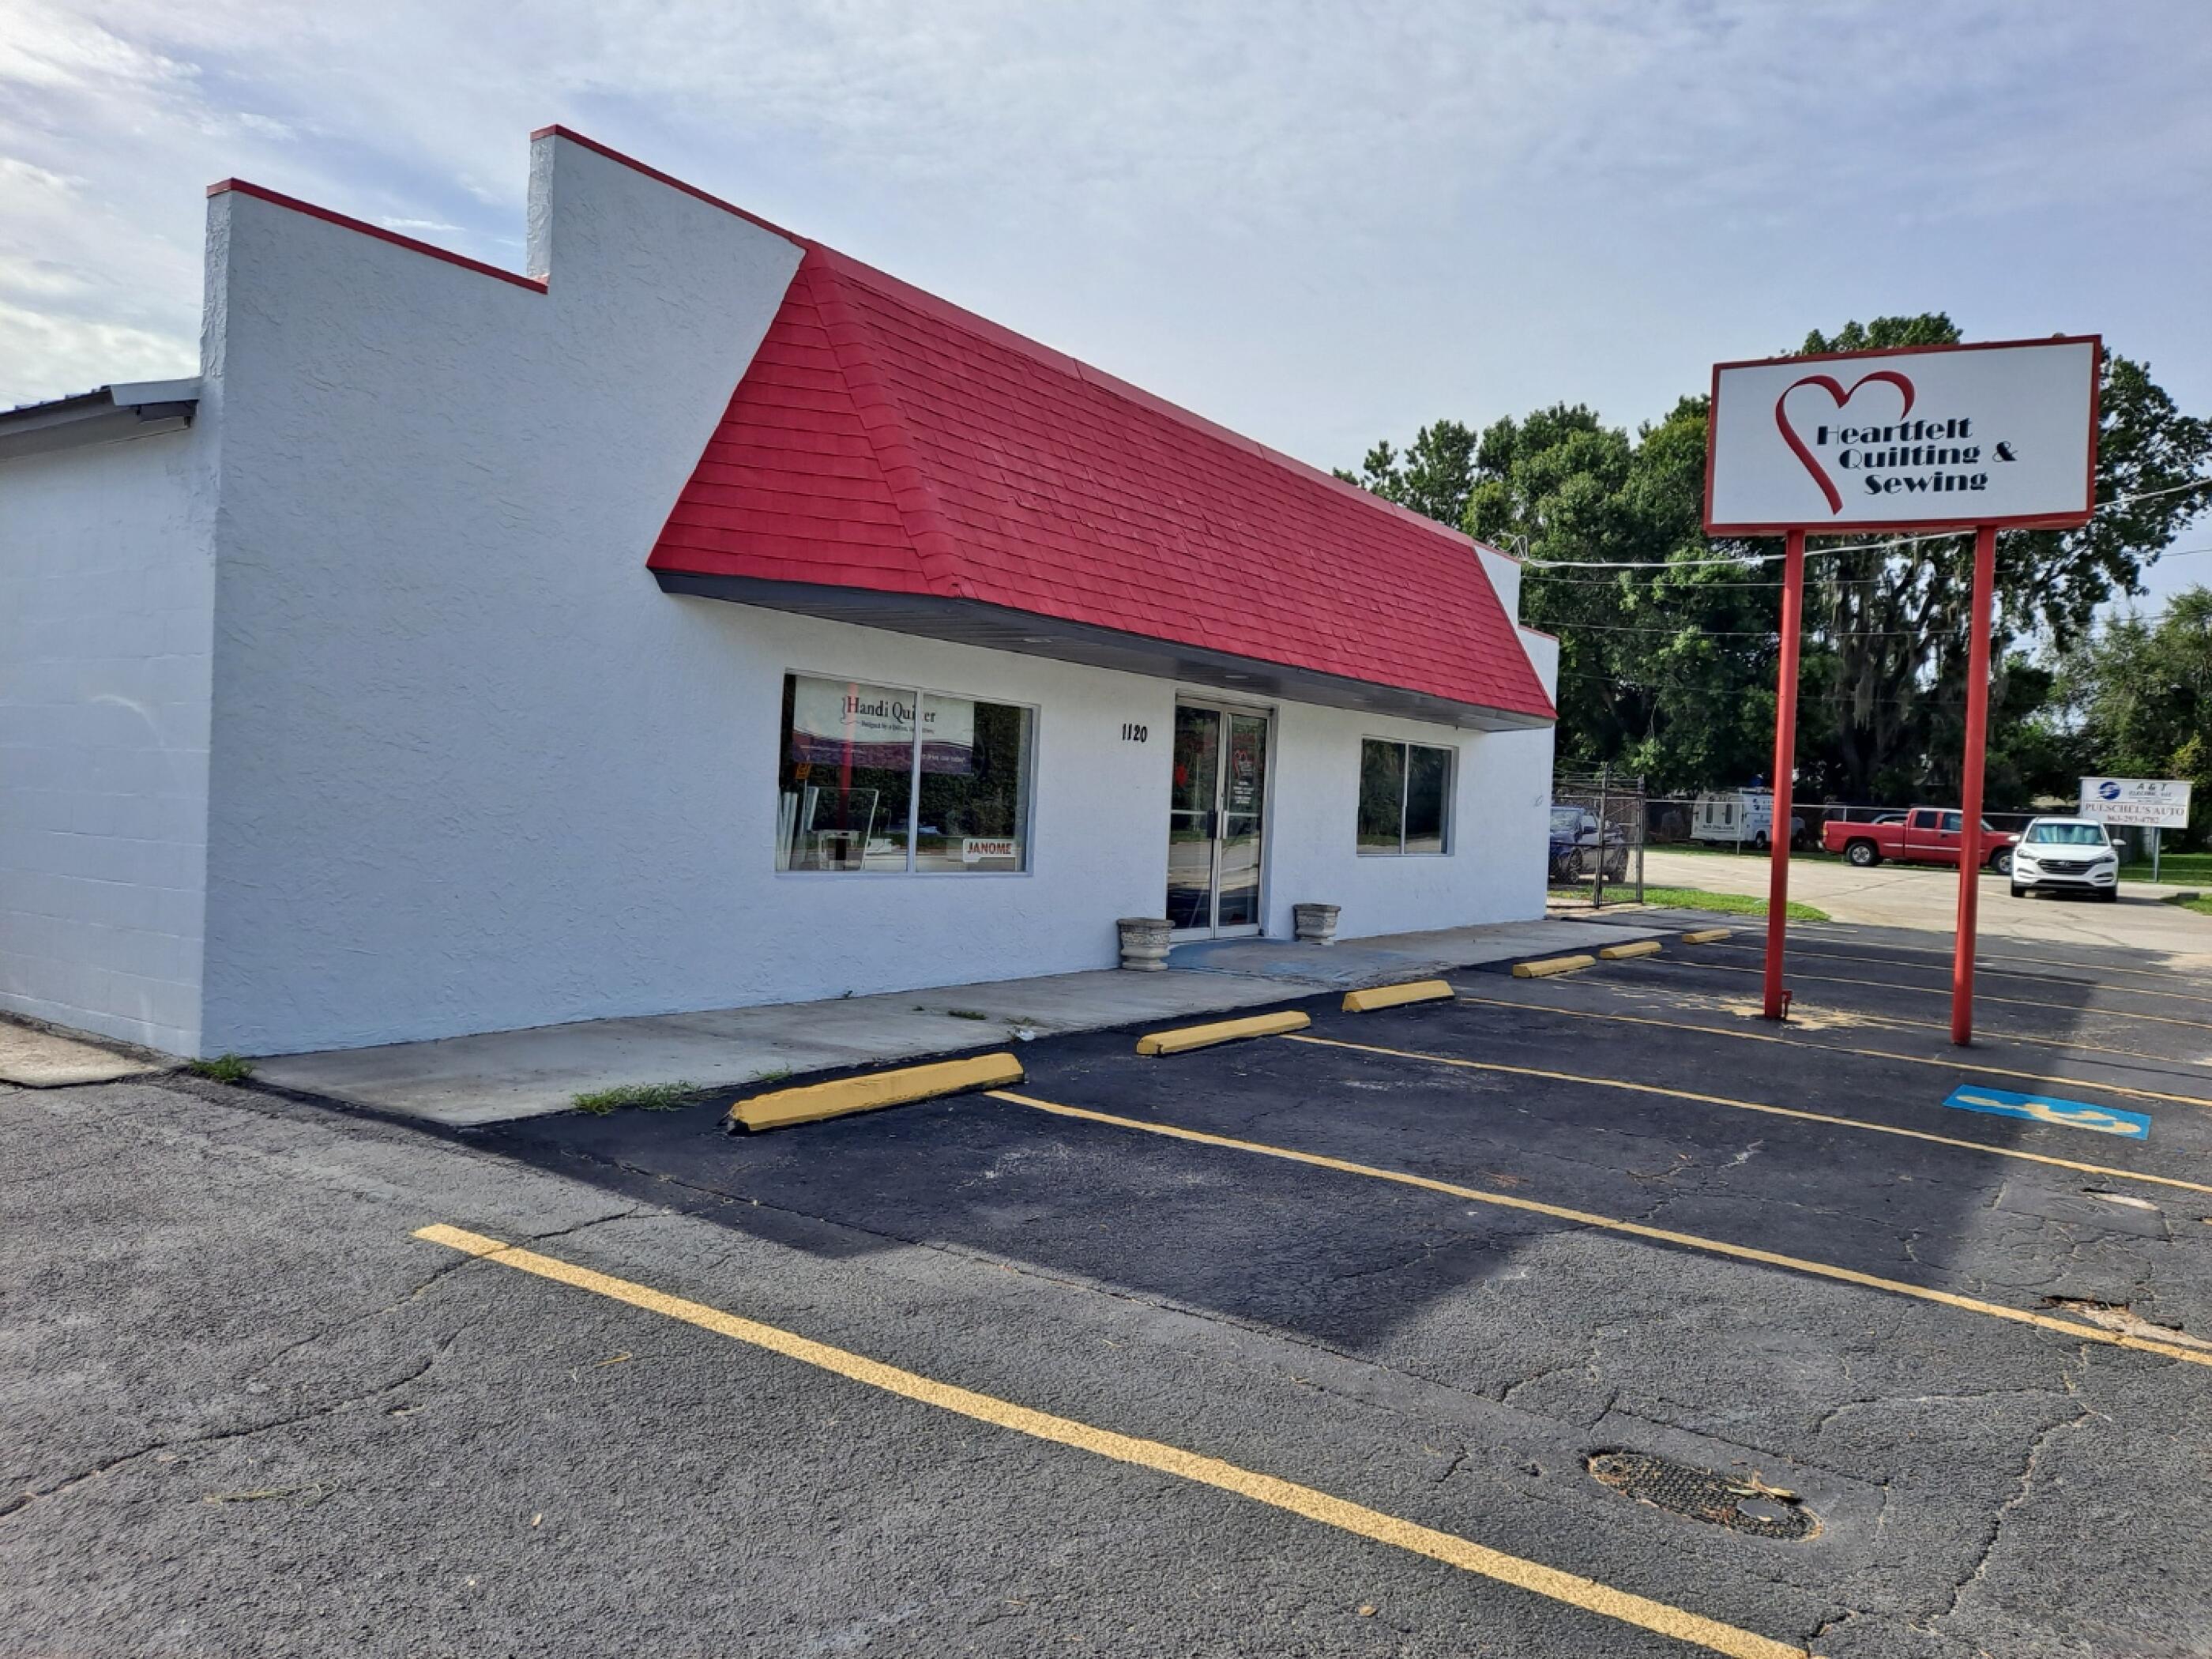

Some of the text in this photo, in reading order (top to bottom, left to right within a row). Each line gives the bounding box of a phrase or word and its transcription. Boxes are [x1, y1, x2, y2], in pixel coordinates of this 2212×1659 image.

[1817, 418, 1973, 446] Heartfelt
[1839, 441, 2018, 470] Quilting &
[1864, 471, 1988, 495] Sewing
[847, 695, 935, 724] Handi Quier
[1122, 723, 1148, 743] 1120
[2154, 807, 2185, 816] AUTO
[967, 841, 1012, 855] JANOME
